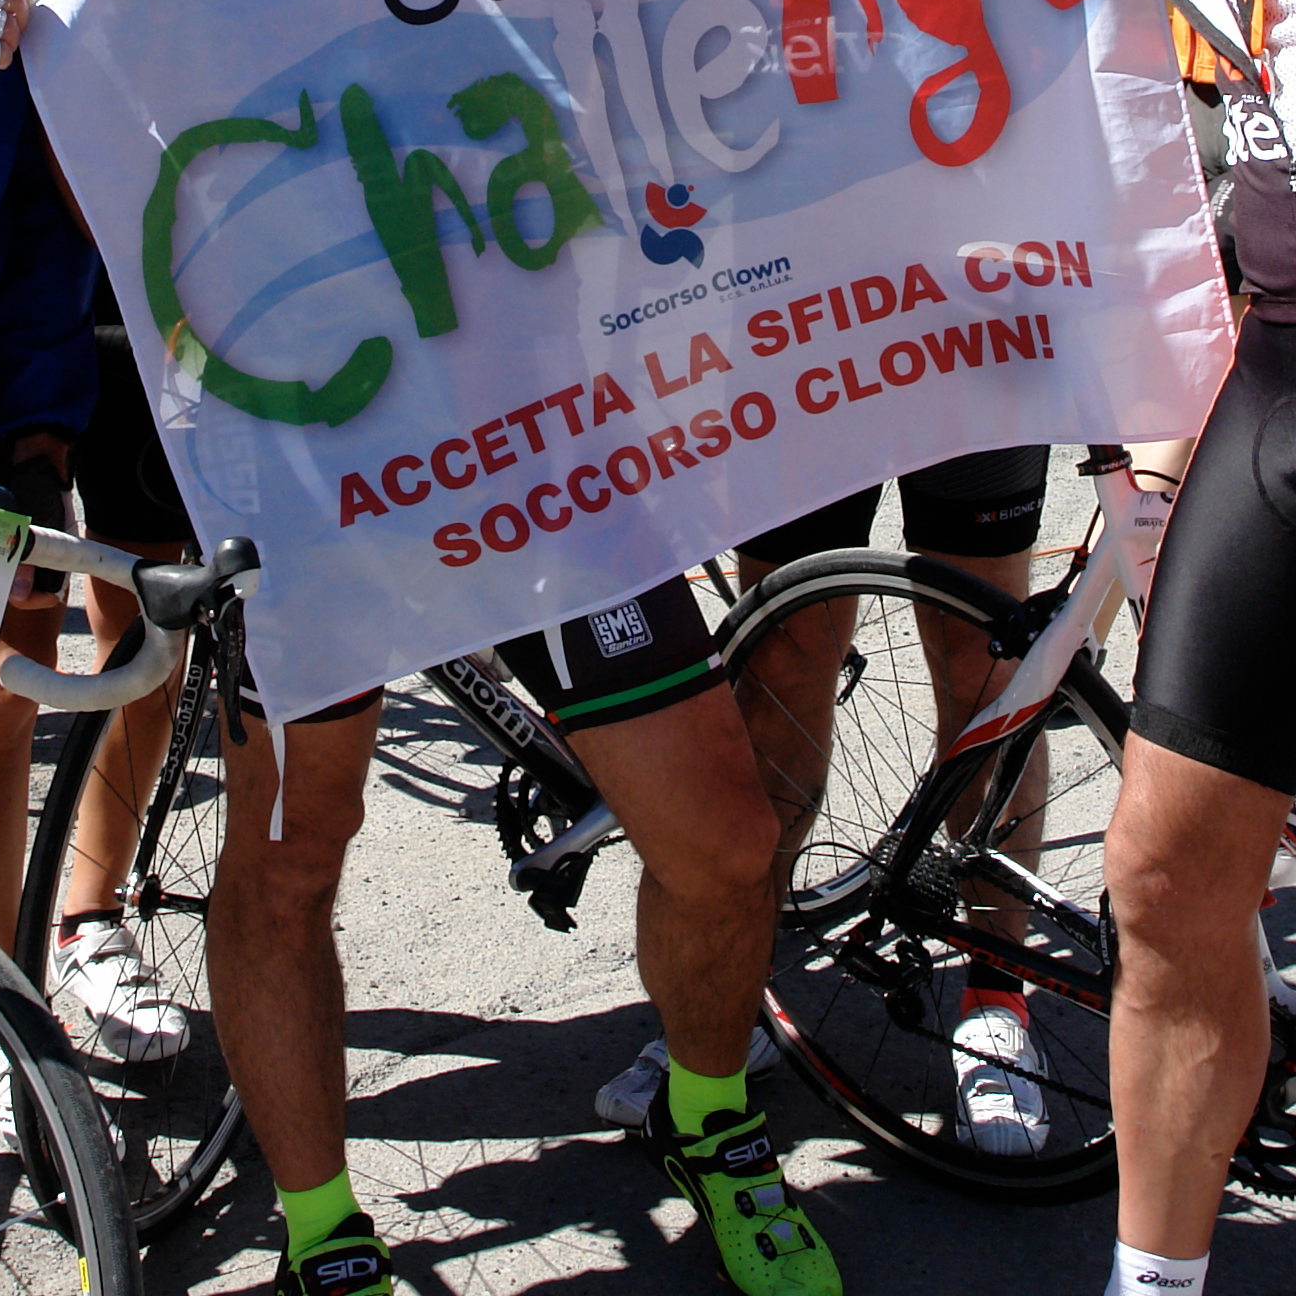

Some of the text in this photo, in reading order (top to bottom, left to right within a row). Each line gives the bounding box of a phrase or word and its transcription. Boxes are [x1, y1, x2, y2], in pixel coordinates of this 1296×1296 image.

[599, 255, 792, 337] Soccorso Clown
[337, 239, 1095, 529] ACCETTA LA SFIDA CON
[431, 312, 1055, 569] SOCCORSO CLOWN!
[998, 503, 1036, 521] BIONIC
[593, 604, 645, 645] SMS
[723, 1134, 773, 1171] SIDI
[315, 1255, 379, 1288] SIDI
[1136, 1270, 1197, 1290] asics
